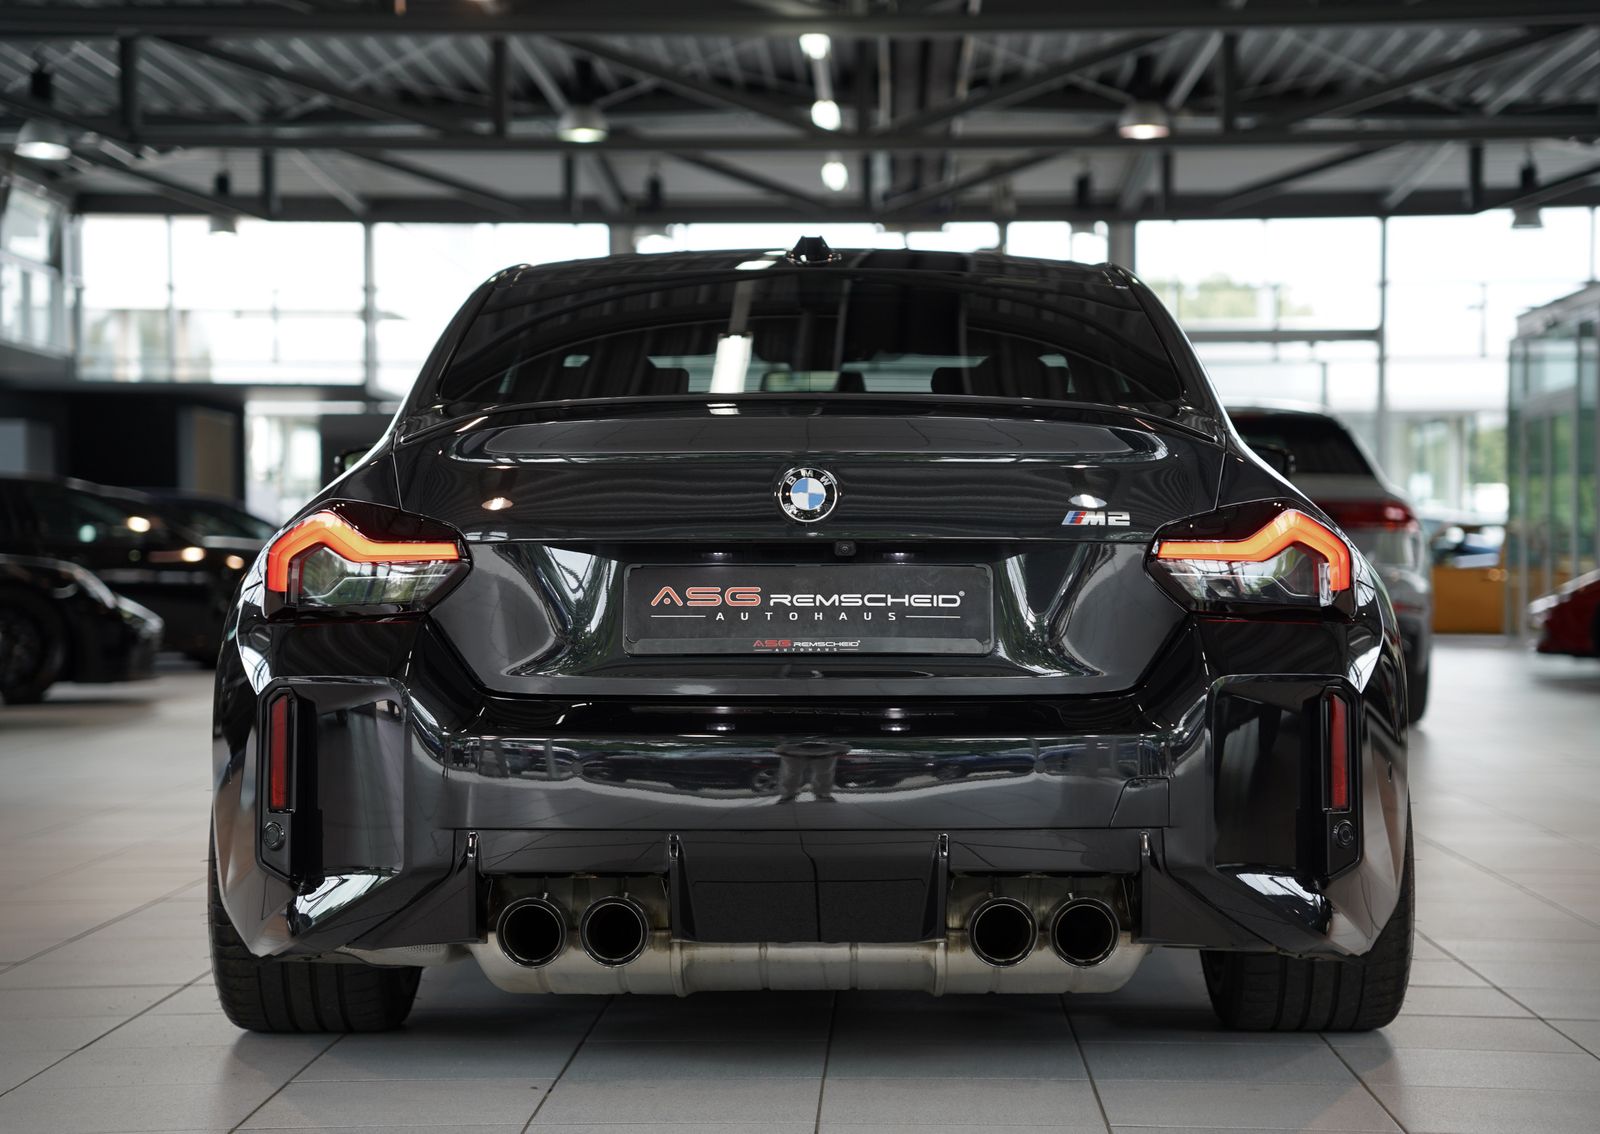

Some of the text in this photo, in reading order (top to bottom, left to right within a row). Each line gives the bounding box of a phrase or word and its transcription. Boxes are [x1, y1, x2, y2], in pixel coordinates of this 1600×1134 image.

[786, 469, 832, 486] BMW
[1078, 510, 1131, 526] M2
[651, 586, 761, 607] ASG
[716, 612, 896, 620] AUTOHAUS
[753, 640, 792, 648] ASG
